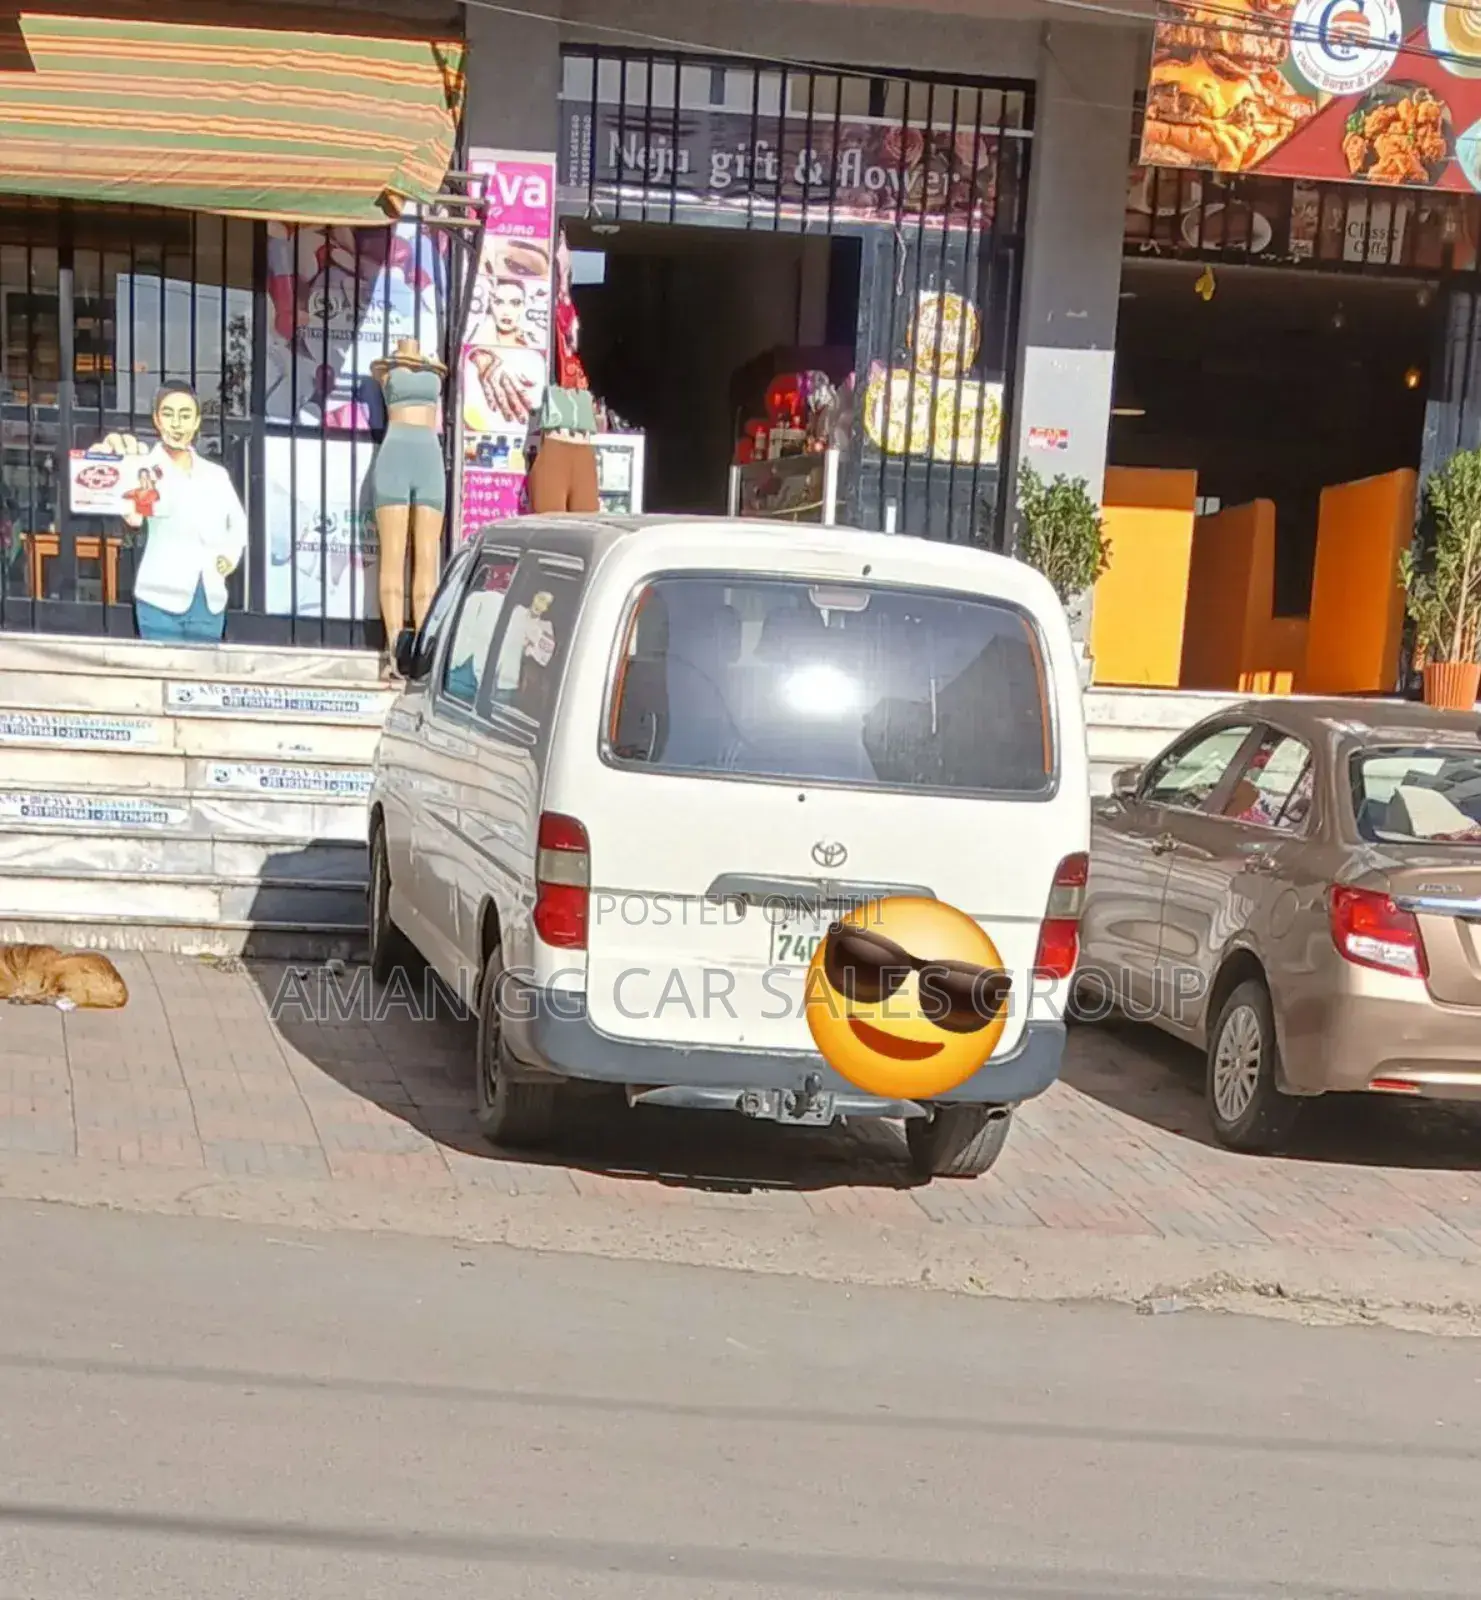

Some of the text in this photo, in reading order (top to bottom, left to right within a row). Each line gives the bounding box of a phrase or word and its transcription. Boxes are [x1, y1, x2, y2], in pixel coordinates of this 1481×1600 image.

[608, 130, 960, 194] Neju gift & flower
